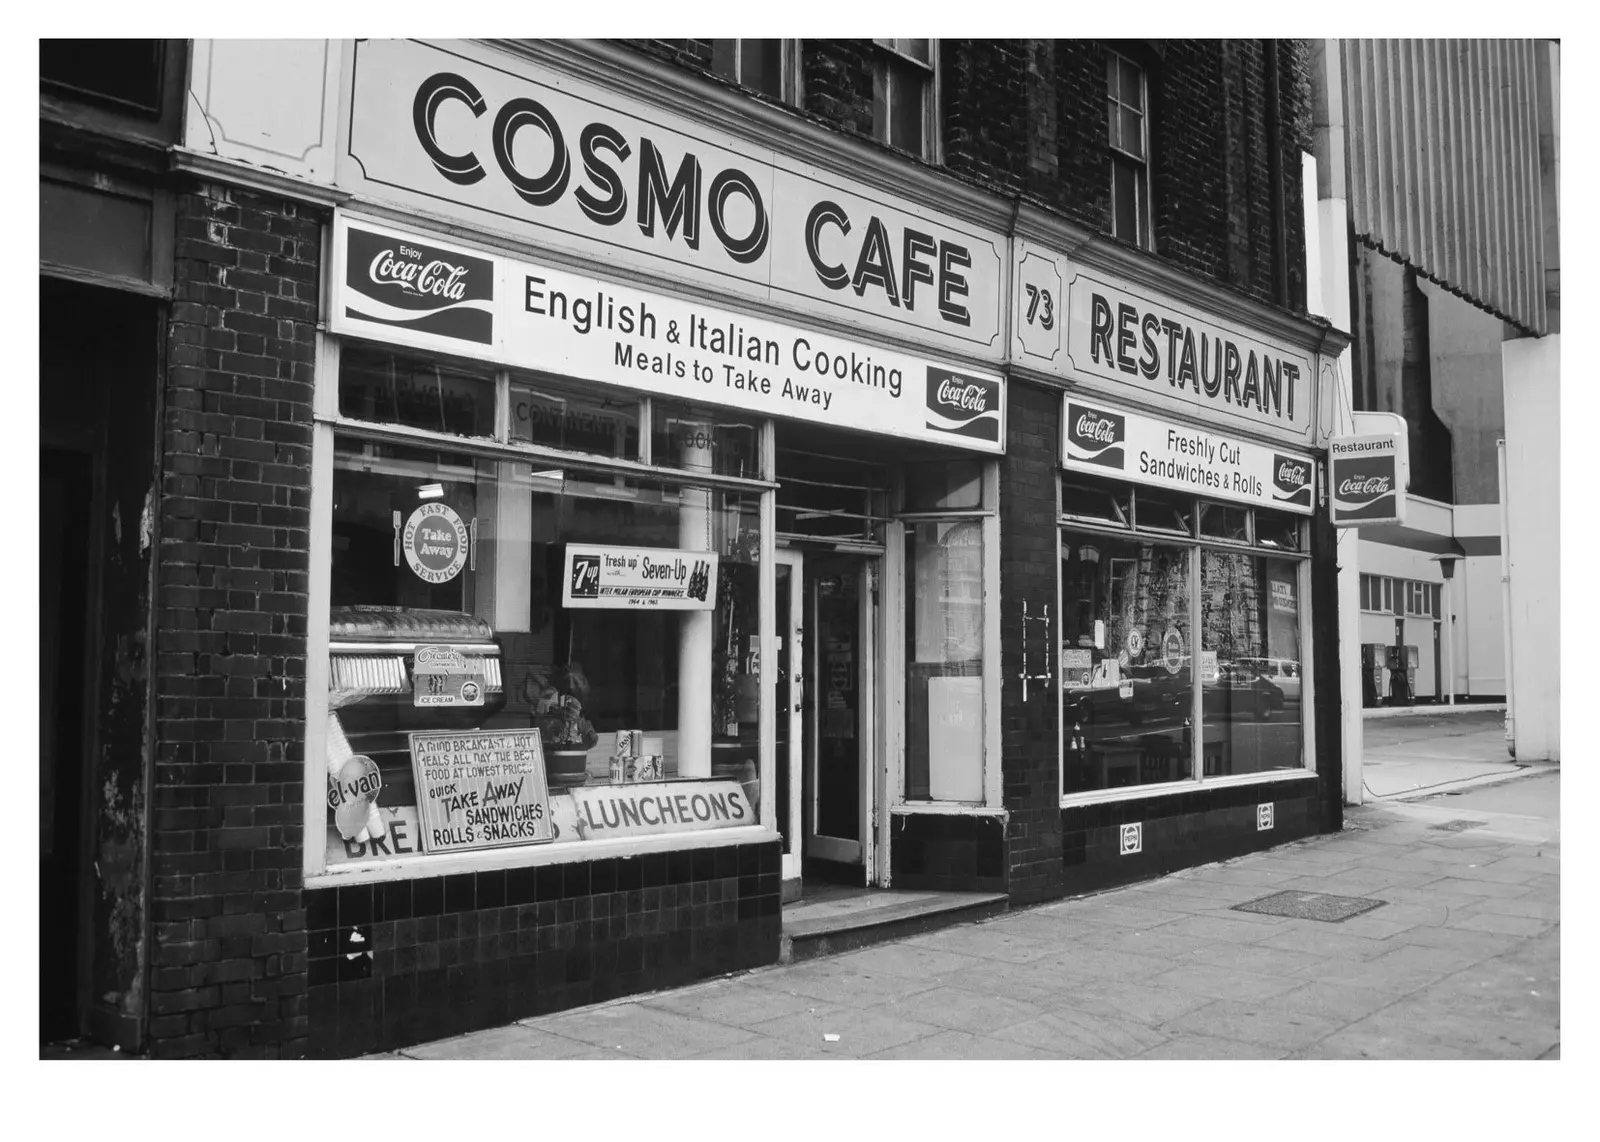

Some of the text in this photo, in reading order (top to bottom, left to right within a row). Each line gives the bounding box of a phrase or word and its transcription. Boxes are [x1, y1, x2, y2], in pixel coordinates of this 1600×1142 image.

[412, 71, 971, 327] COSMO CAFE
[400, 245, 422, 260] Enjoy
[369, 249, 469, 300] Coca-Cola
[1025, 283, 1054, 330] 73
[525, 275, 901, 398] English & Italian Cooking
[1090, 292, 1299, 421] RESTAURANT
[615, 342, 832, 410] Meals to Take Away
[952, 376, 964, 385] Enjoy
[937, 379, 987, 412] Coca-Cola
[1076, 414, 1115, 443] Coca-Cola
[1168, 429, 1240, 465] Freshly Cut
[1332, 439, 1394, 453] Restaurant
[1140, 451, 1262, 496] Sandwiches & Rolls
[1279, 463, 1305, 485] Coca-Cola
[1339, 476, 1390, 495] Coca-Cola
[405, 504, 467, 554] HOT FAST FOOD
[421, 528, 452, 541] Take
[420, 543, 454, 558] Away
[413, 560, 461, 581] SERVICE
[642, 556, 686, 585] Seven-Up
[514, 737, 531, 749] HOT
[453, 754, 472, 765] ALL
[494, 751, 511, 762] THE
[425, 768, 450, 780] FOOD
[453, 767, 463, 778] AT
[466, 765, 500, 778] LOWEST
[429, 783, 457, 798] QUICK
[441, 776, 524, 823] TAKE AWAY
[466, 804, 543, 825] SANDWICHES
[583, 792, 745, 829] LUNCHEONS
[433, 826, 475, 846] ROLLS
[483, 822, 535, 841] SNACKS
